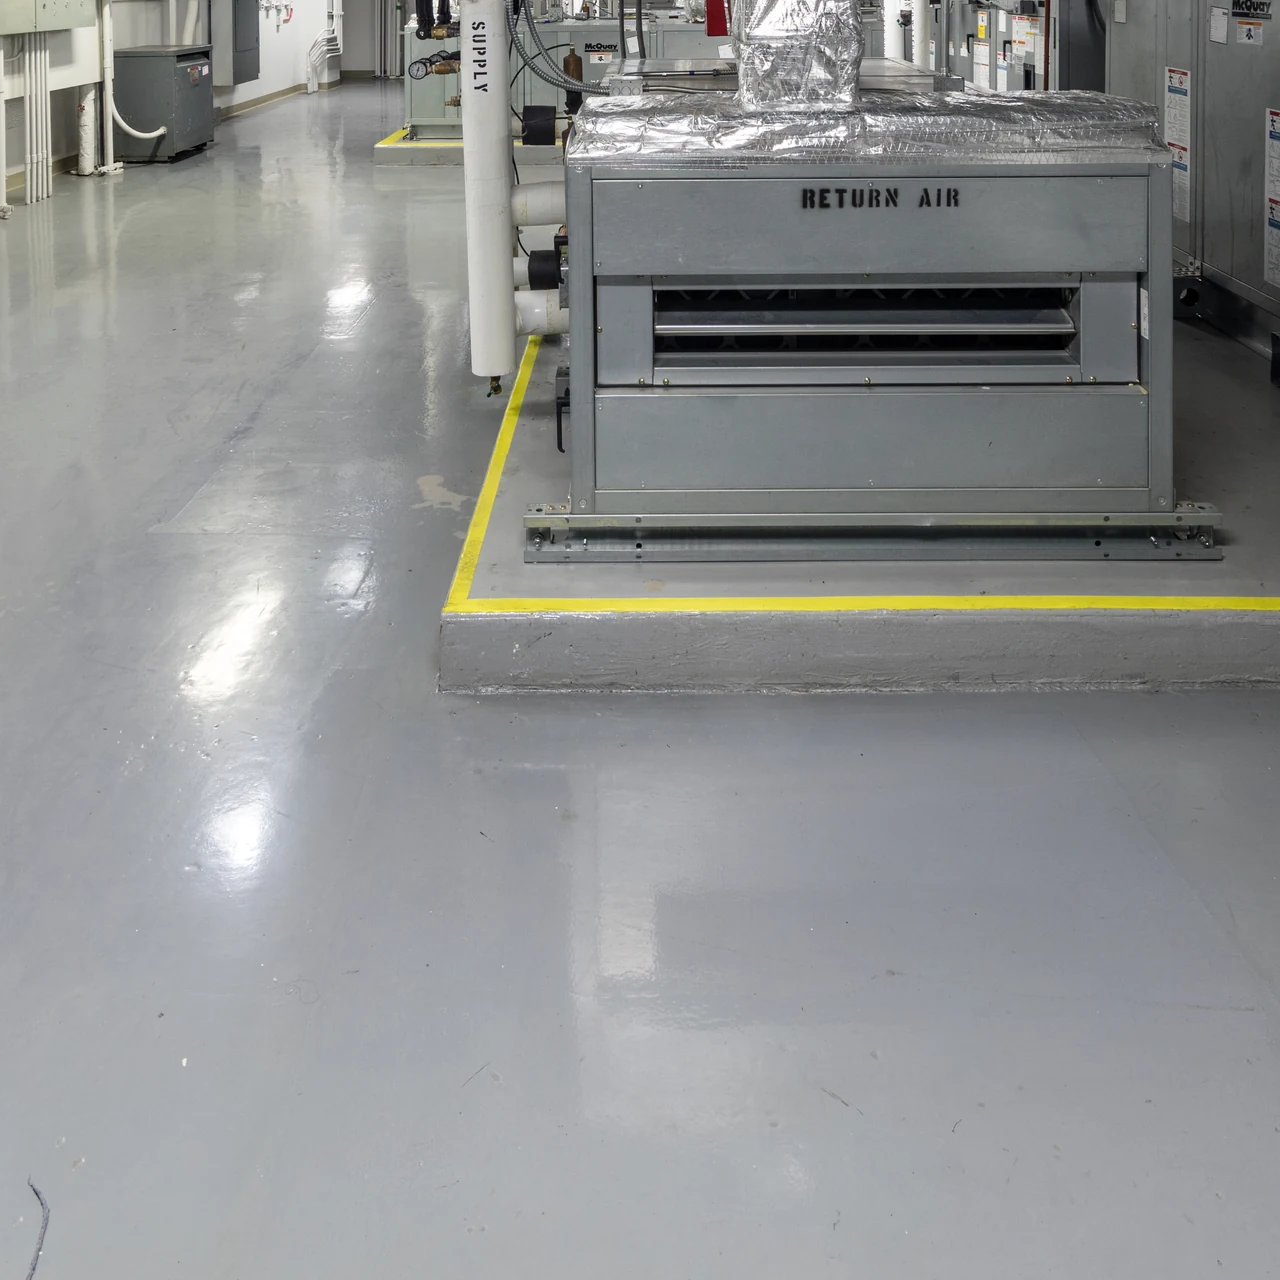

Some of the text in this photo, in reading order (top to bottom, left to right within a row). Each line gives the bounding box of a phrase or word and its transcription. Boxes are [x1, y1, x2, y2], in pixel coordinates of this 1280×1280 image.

[472, 21, 488, 92] SUPPLY
[584, 42, 618, 51] McQuay
[802, 188, 959, 208] RETURN AIR
